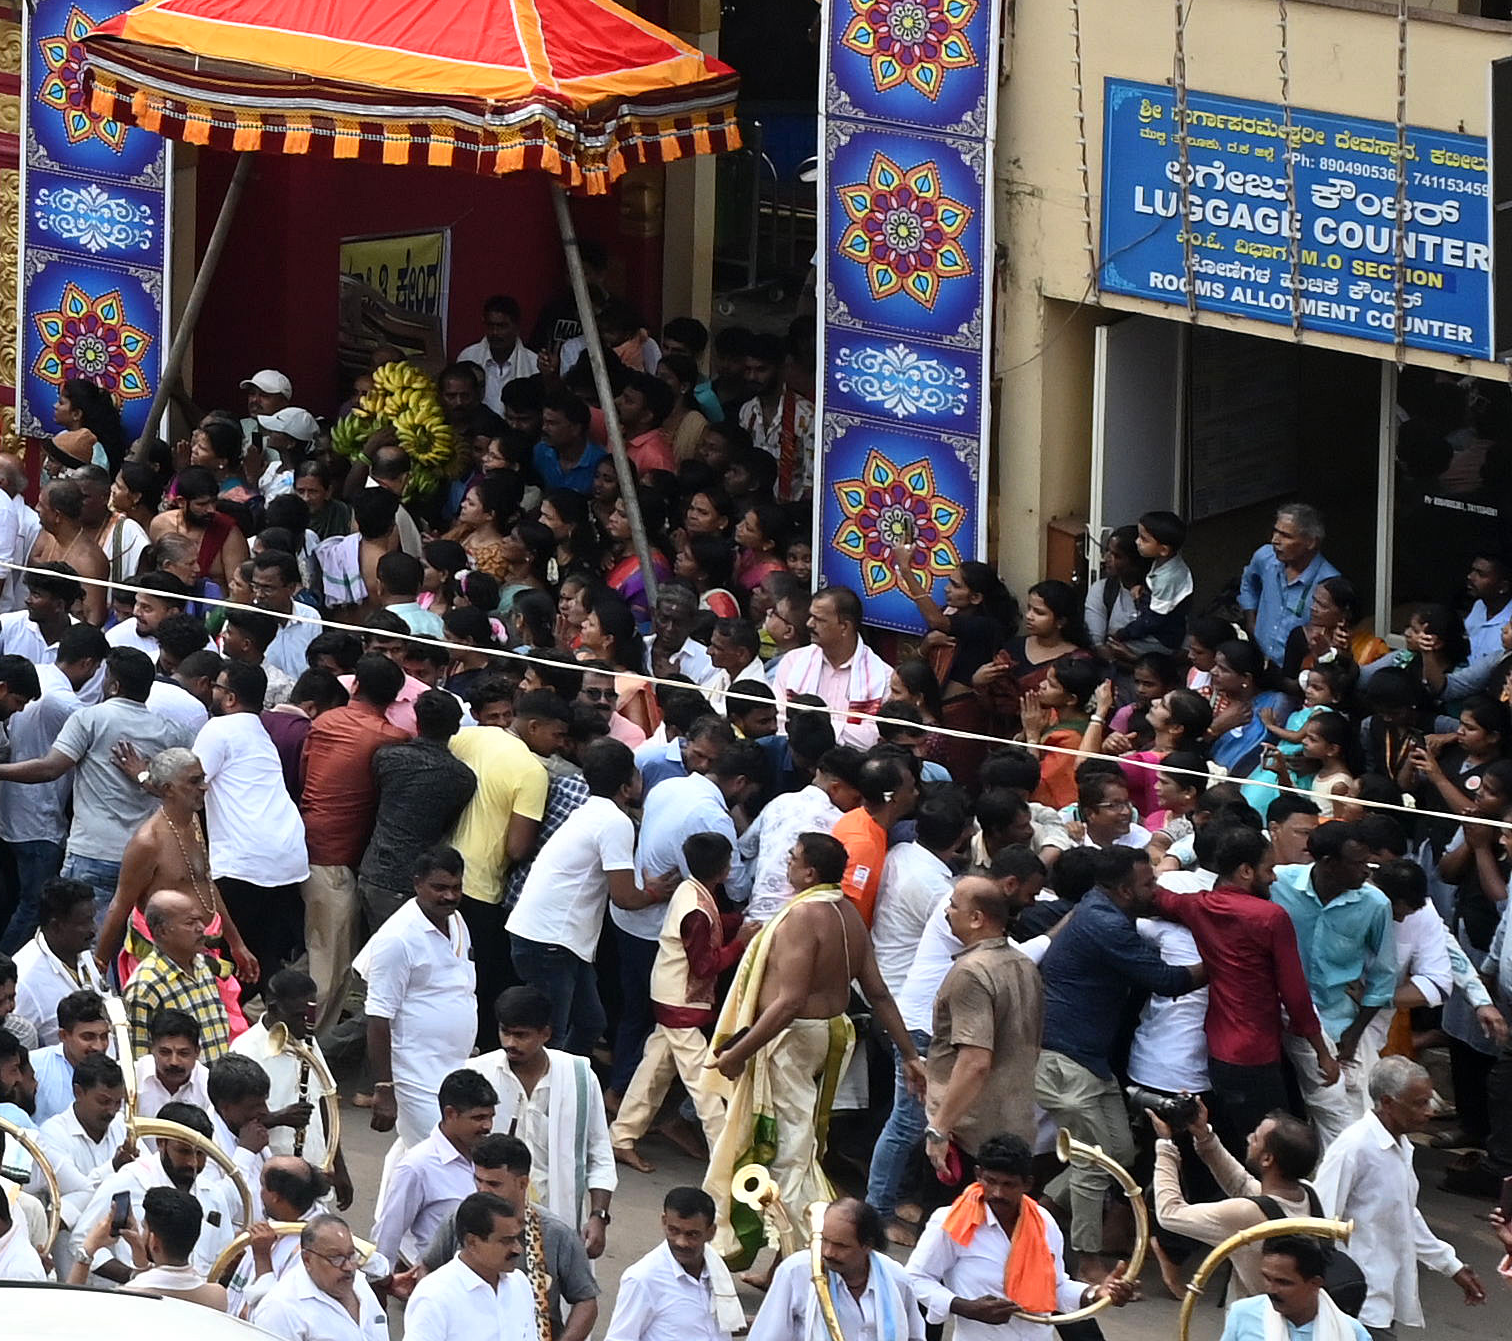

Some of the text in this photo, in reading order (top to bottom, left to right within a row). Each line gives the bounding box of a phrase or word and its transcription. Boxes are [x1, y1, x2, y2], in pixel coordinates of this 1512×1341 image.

[1137, 98, 1163, 124] ಶ್ರೀ
[1291, 151, 1315, 168] Ph:
[1319, 156, 1409, 186] 890490536,
[1134, 185, 1490, 272] LUGGAGE COUNTER
[1351, 259, 1443, 289] SECTION
[1149, 271, 1473, 344] ROOMS ALLOTMENT COUNTER
